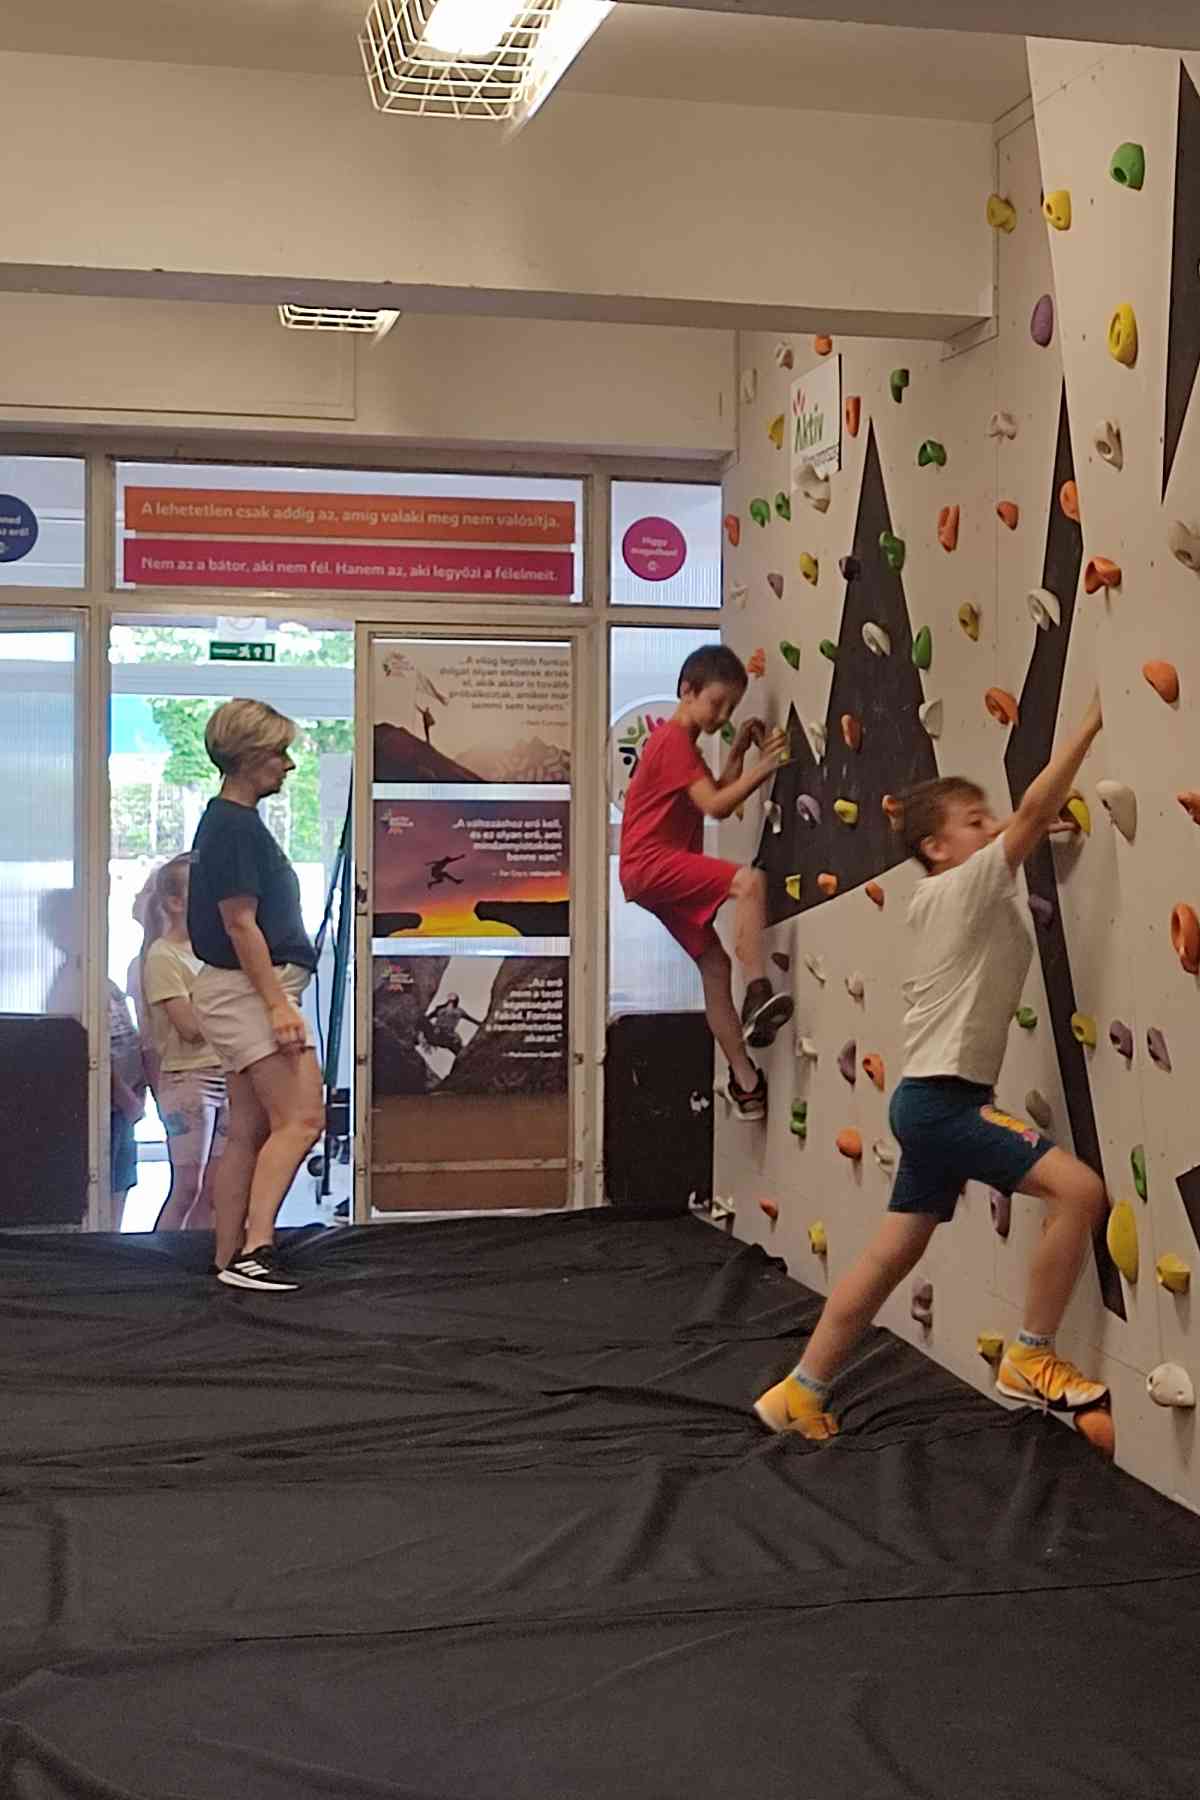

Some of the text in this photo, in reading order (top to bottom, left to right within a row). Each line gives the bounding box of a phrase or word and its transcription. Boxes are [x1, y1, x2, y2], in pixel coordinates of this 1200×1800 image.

[142, 501, 153, 515] A
[156, 502, 233, 518] lehetetlen
[236, 505, 270, 519] csak
[273, 506, 315, 523] addig
[318, 509, 338, 522] az,
[382, 510, 424, 525] valaki
[427, 514, 459, 529] meg
[462, 514, 494, 526] nem
[496, 512, 560, 531] valósítja.
[141, 557, 559, 582] Nem az a bátor, aki nem fél. Hanem az, aki legyőzi a félelmeit.
